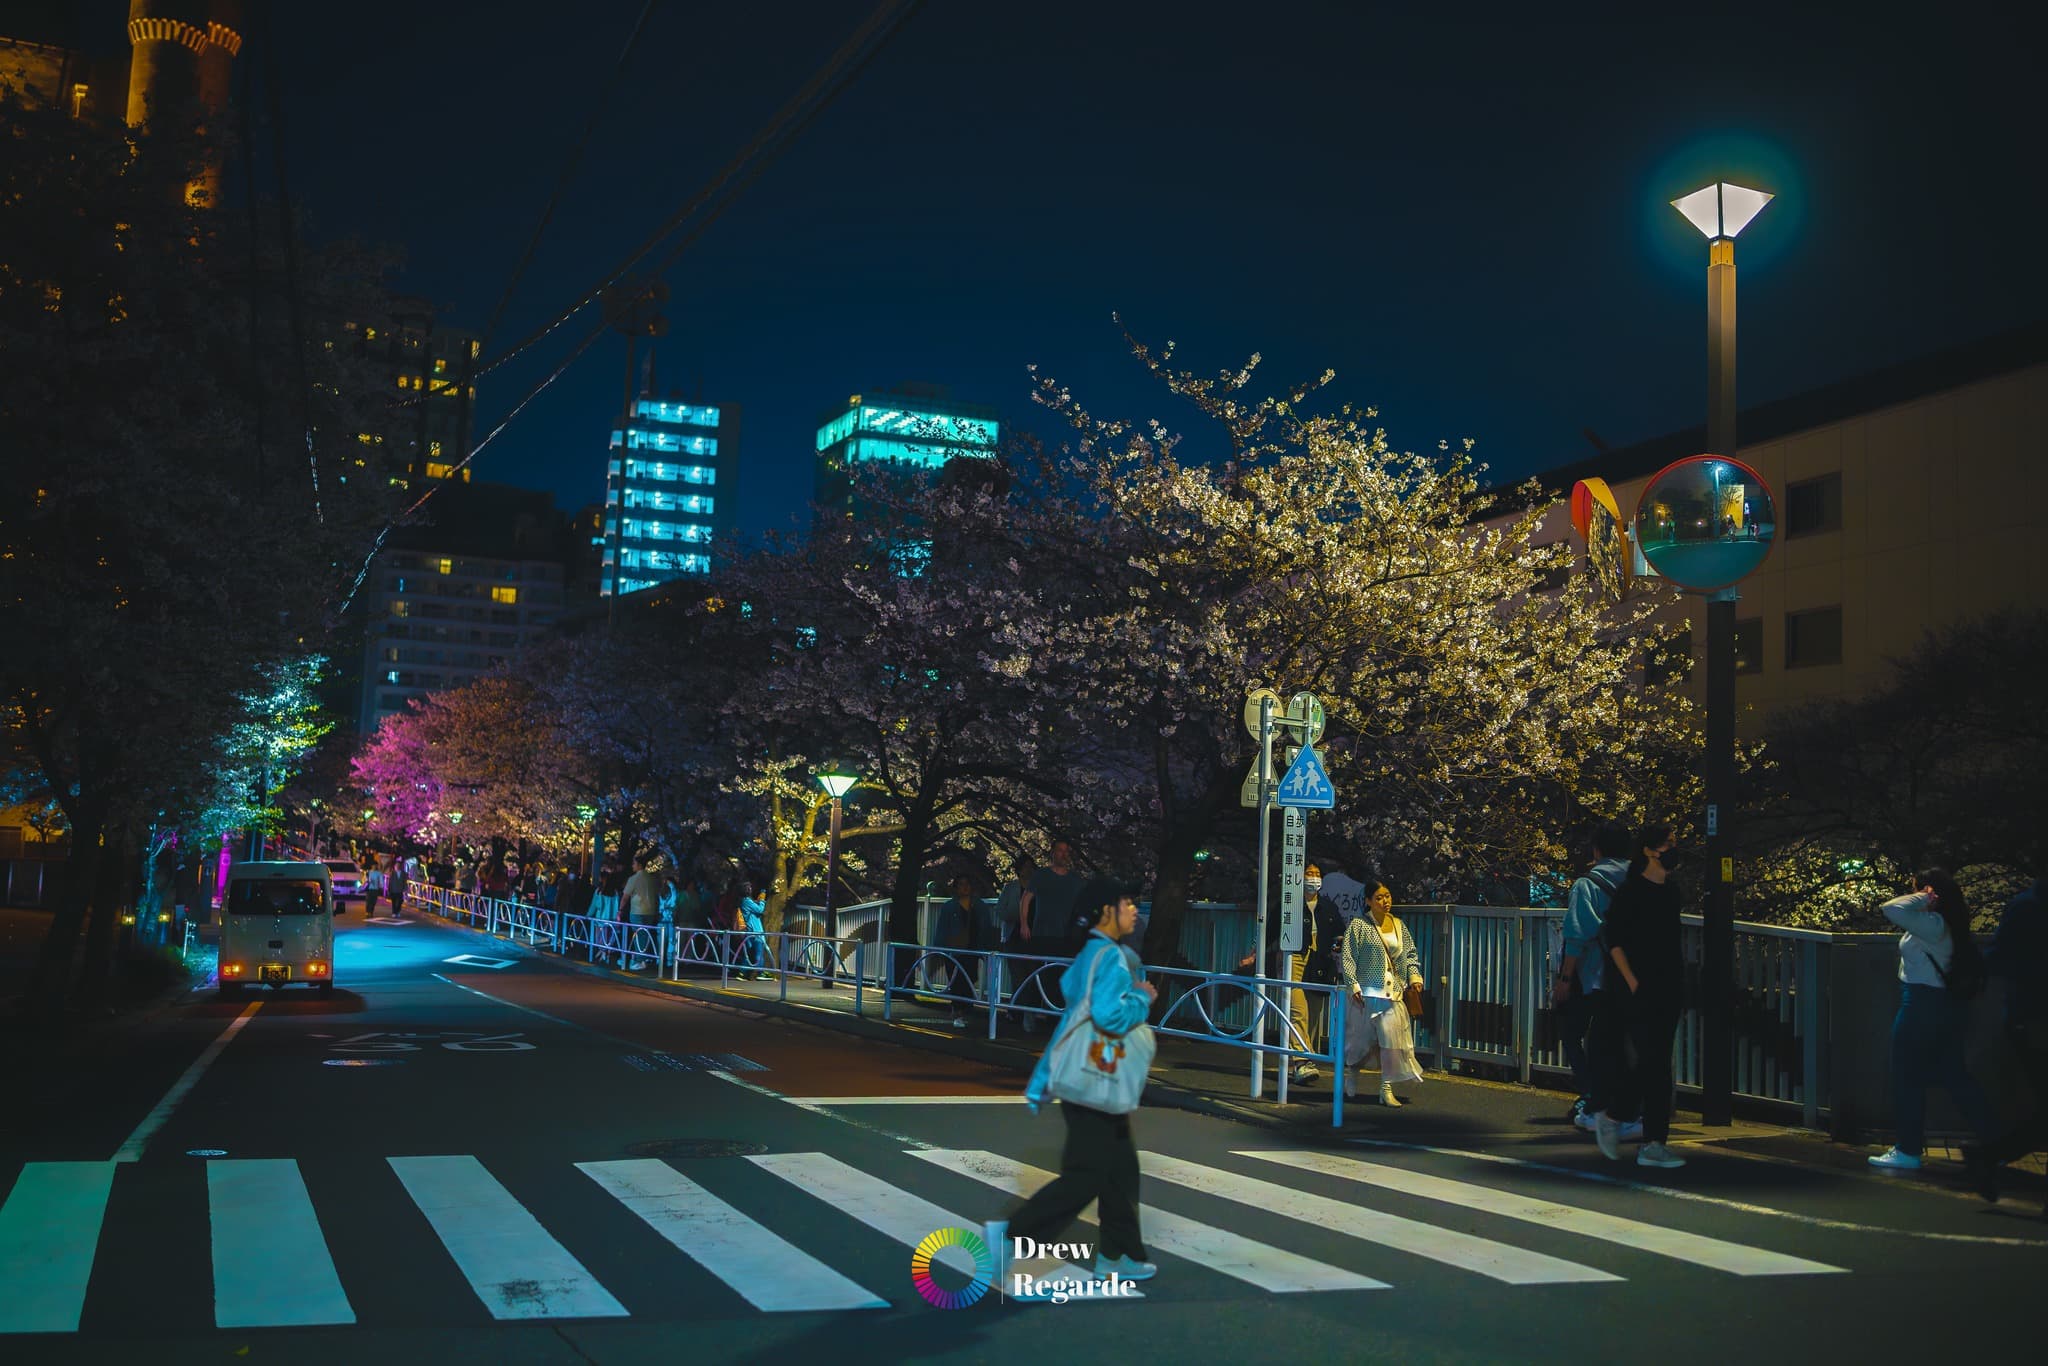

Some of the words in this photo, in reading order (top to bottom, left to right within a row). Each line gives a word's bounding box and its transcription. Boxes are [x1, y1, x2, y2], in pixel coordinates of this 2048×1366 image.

[1282, 815, 1294, 943] 自転車は車道へ
[1295, 815, 1304, 886] 歩道狭し
